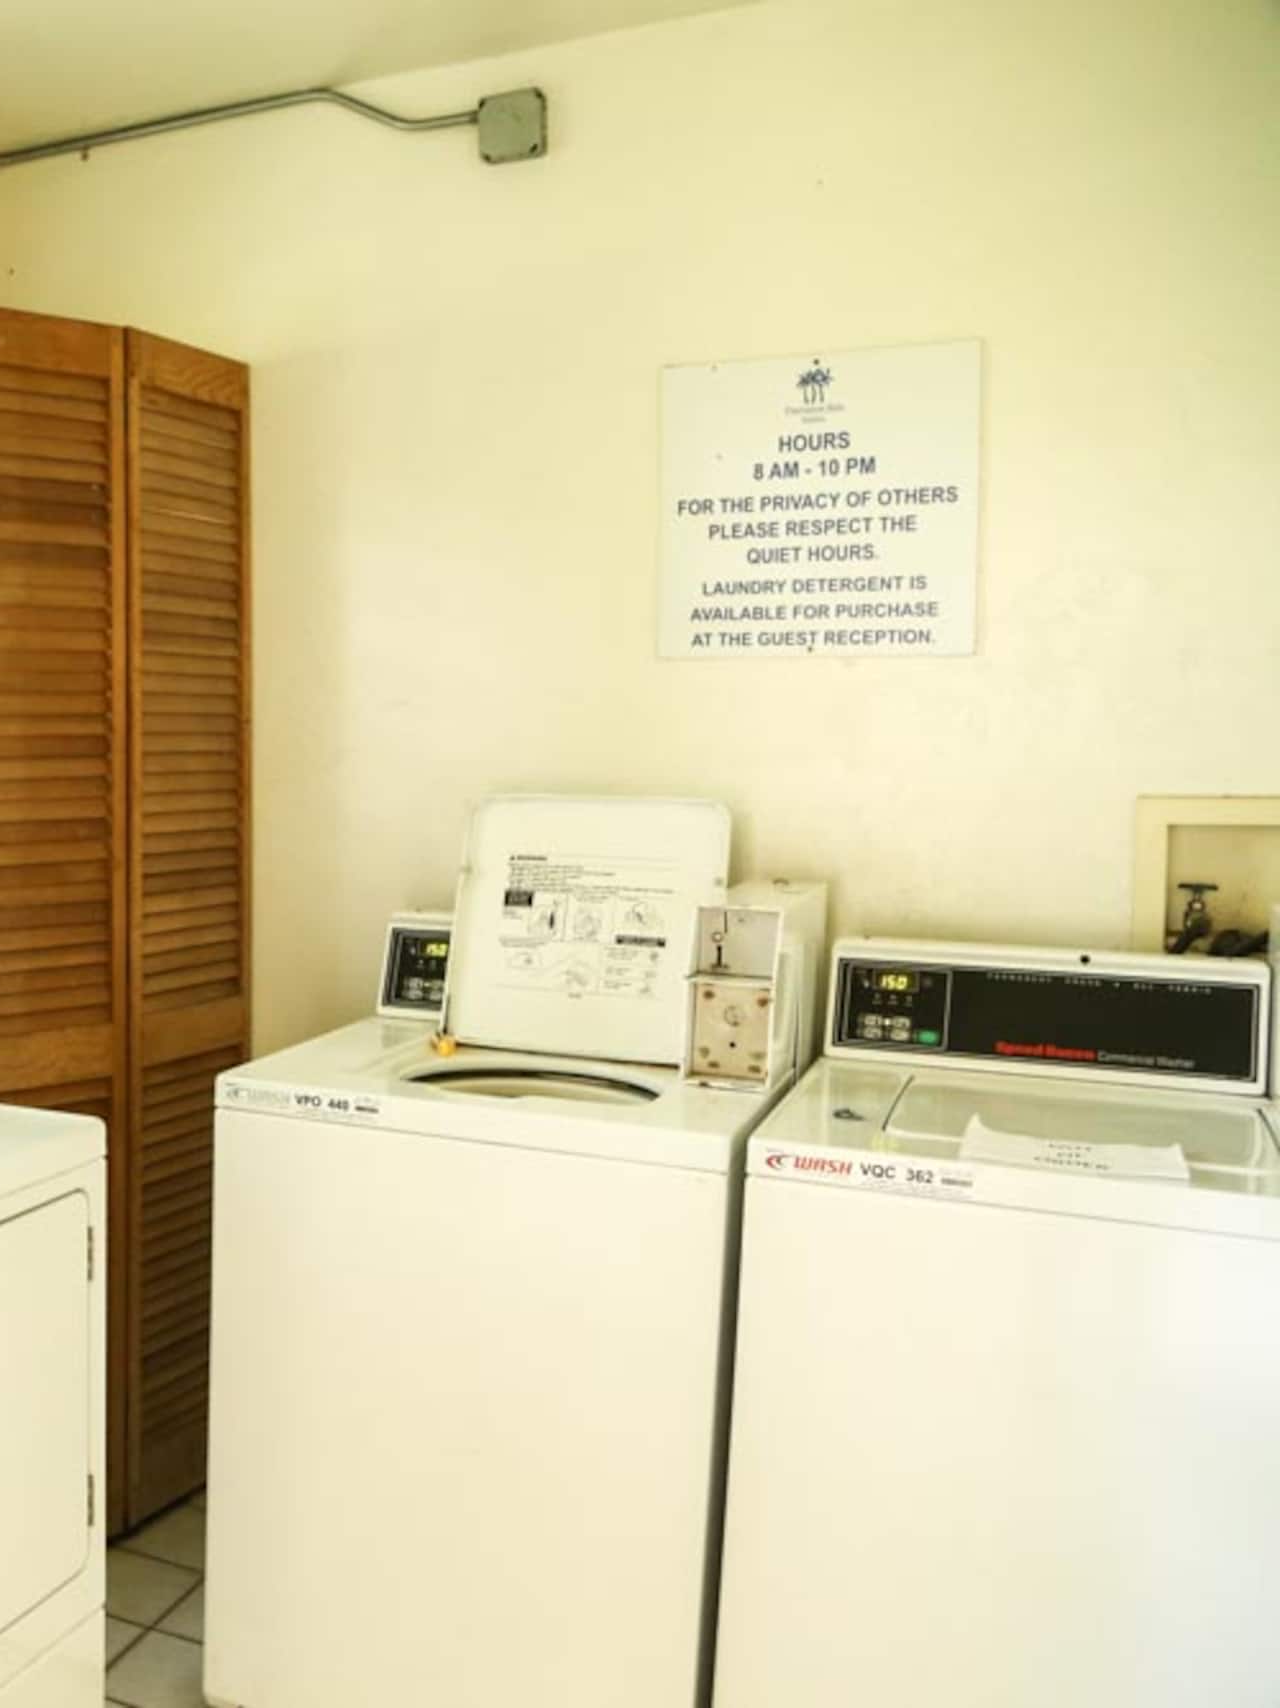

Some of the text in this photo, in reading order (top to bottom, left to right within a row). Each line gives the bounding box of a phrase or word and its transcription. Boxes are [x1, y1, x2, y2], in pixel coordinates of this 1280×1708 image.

[778, 431, 850, 452] HOURS
[753, 463, 764, 480] 8
[769, 461, 799, 480] AM
[819, 459, 839, 477] 10
[846, 457, 875, 475] PM
[677, 486, 958, 516] FOR THE PRIVACY OF OTHERS
[709, 515, 917, 540] PLEASE RESPECT THE
[747, 544, 878, 565] QUIET HOURS.
[702, 575, 927, 596] LAUNDRY DETERGENT IS
[691, 602, 938, 621] AVAILABLE FOR PURCHASE
[691, 629, 935, 647] AT THE GUEST RECEPTION.
[294, 1095, 322, 1108] VPO
[794, 1156, 853, 1176] WASH
[859, 1162, 896, 1180] VQC
[906, 1168, 933, 1184] 362
